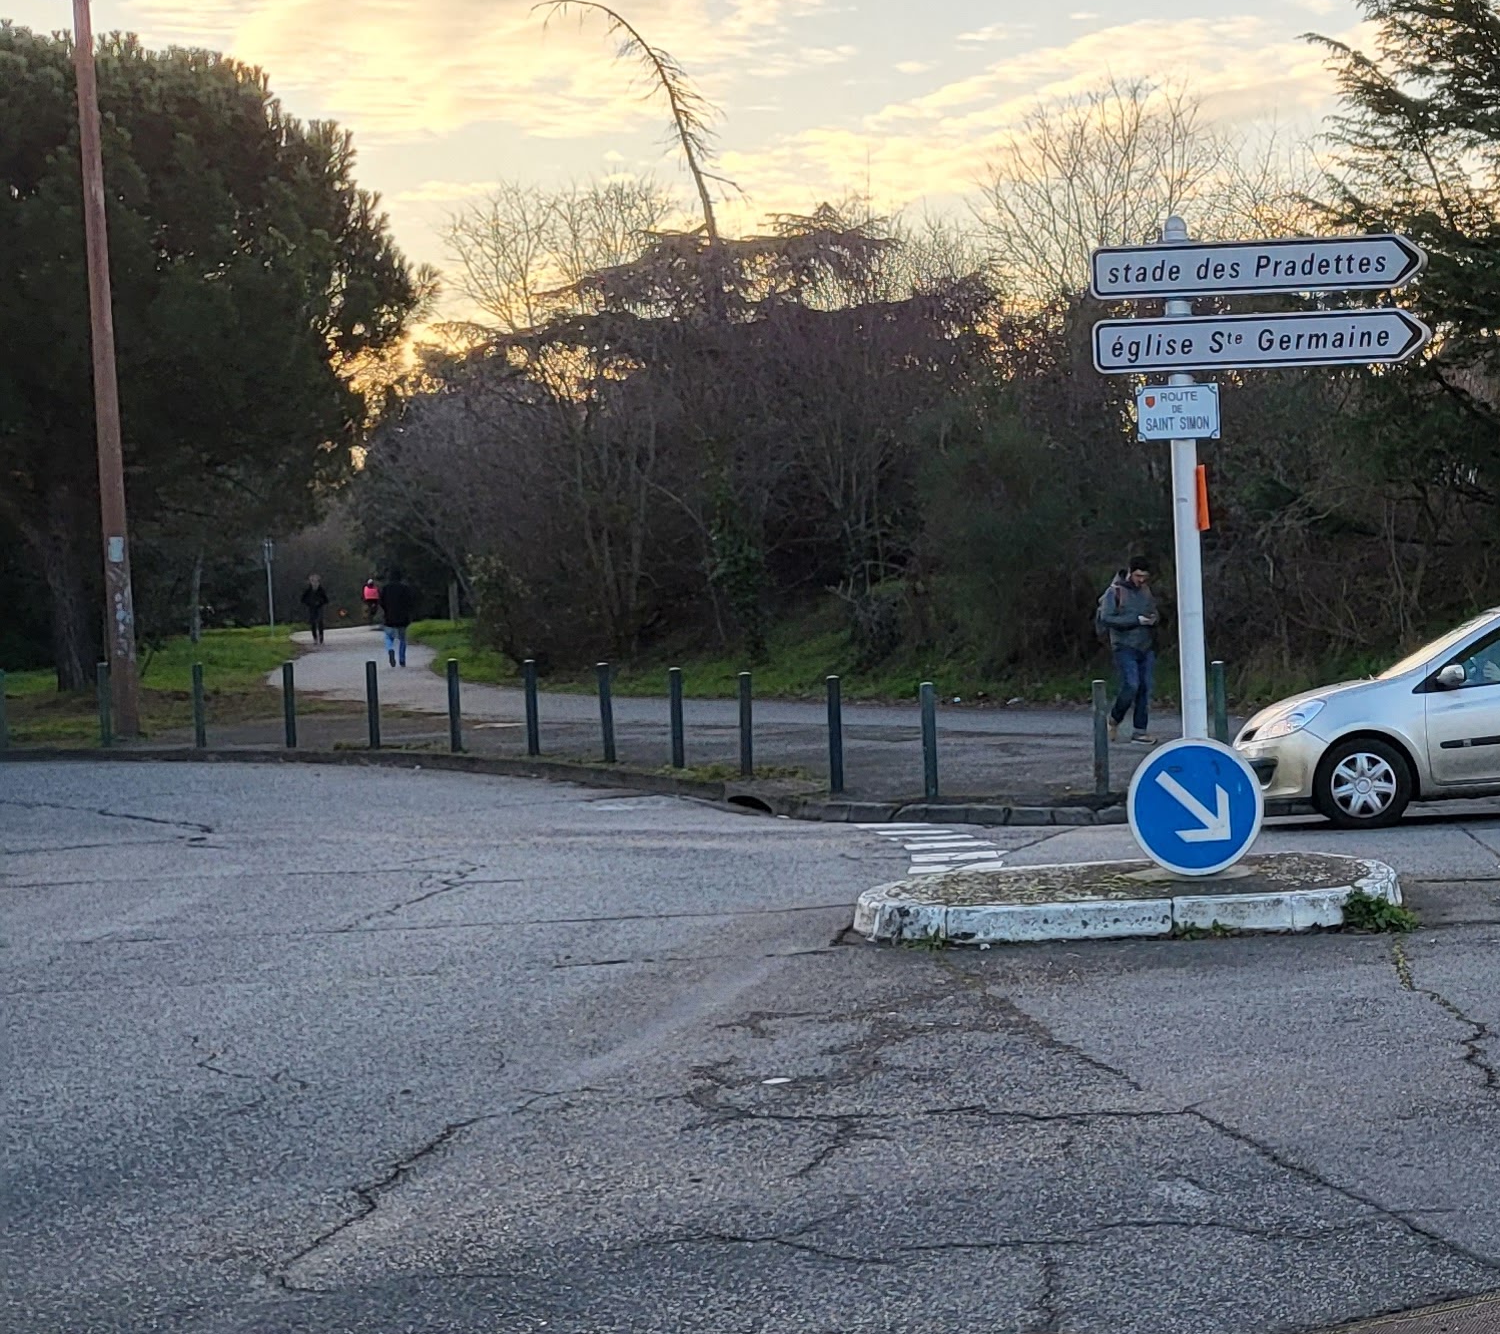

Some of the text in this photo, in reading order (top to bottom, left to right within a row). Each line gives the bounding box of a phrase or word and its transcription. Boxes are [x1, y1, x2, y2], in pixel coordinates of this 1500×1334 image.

[1108, 252, 1387, 284] stade des Pradettes
[1111, 325, 1390, 363] église Ste Germaine
[1159, 391, 1198, 402] ROUTE
[1172, 404, 1183, 414] DE
[1145, 416, 1210, 431] SAINT SIMON
